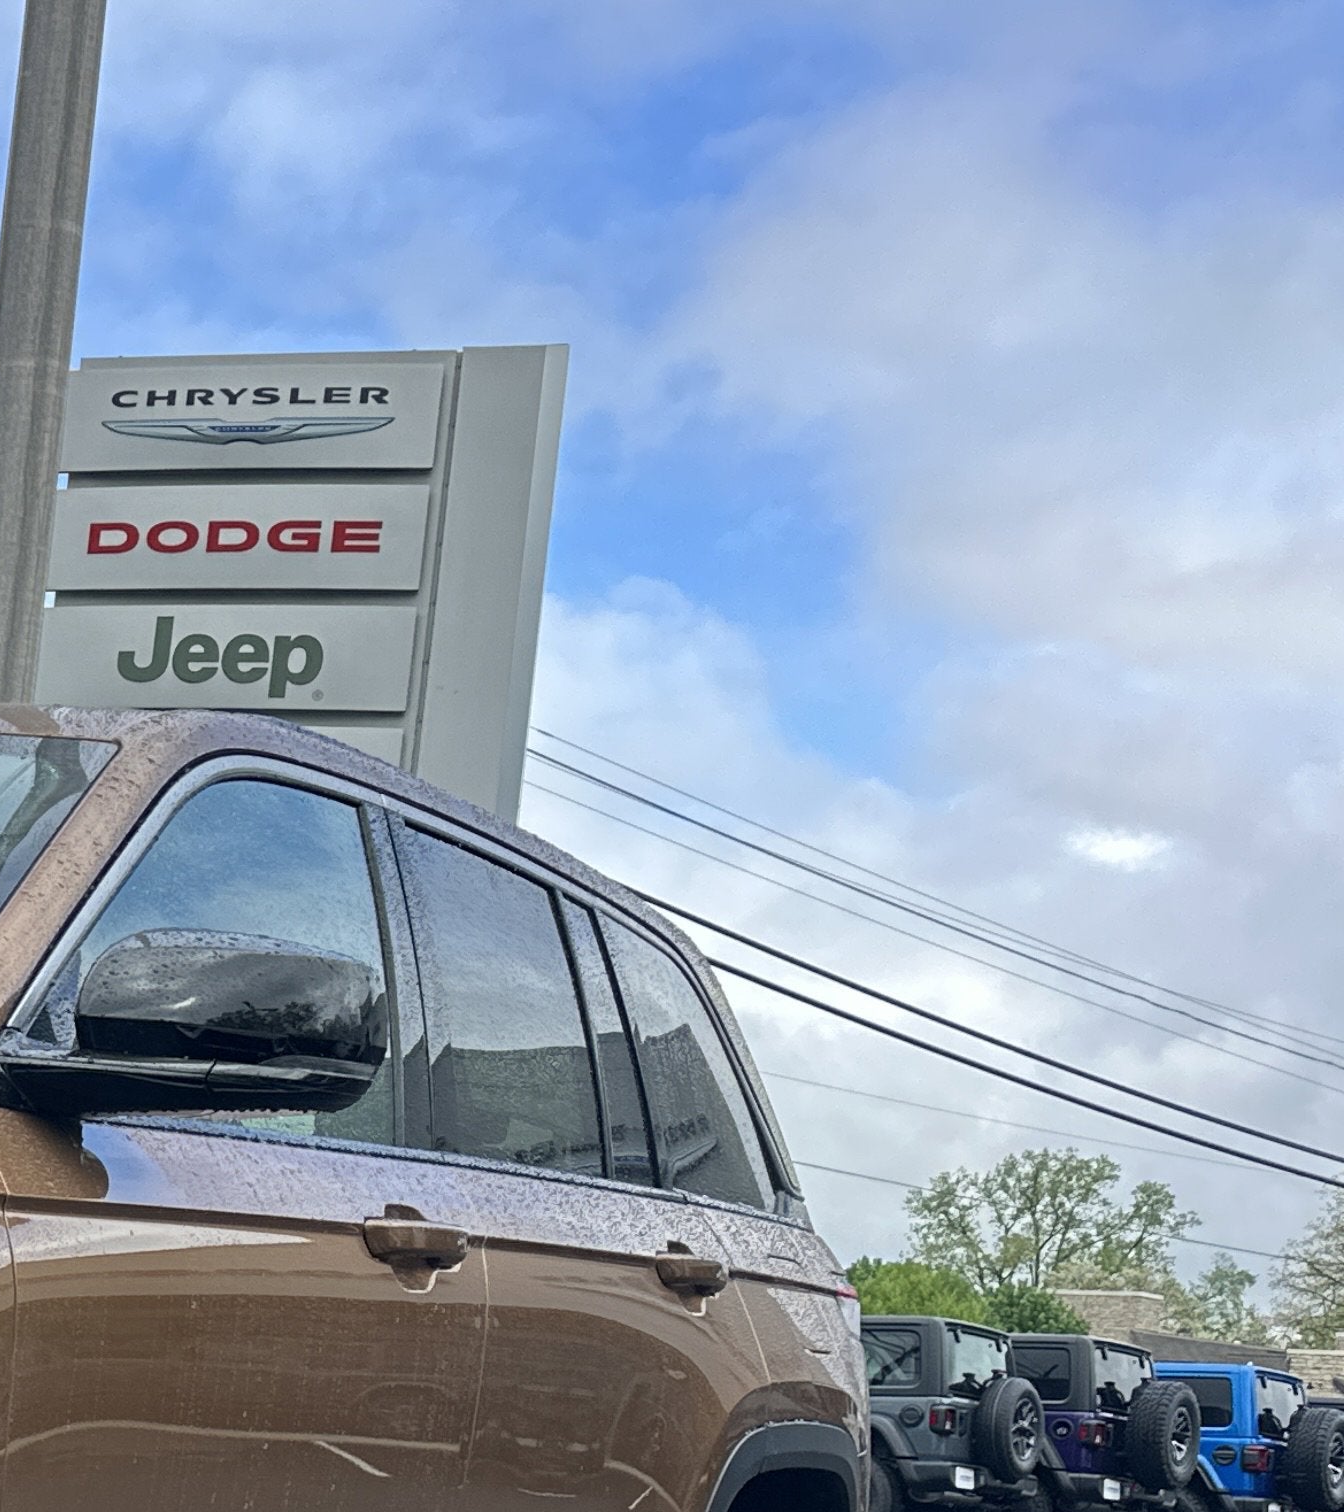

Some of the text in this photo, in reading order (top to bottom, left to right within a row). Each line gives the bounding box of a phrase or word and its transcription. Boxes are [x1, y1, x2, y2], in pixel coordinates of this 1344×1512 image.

[111, 386, 390, 408] CHRYSLER
[86, 520, 384, 554] DODGE
[116, 616, 324, 698] Jeep
